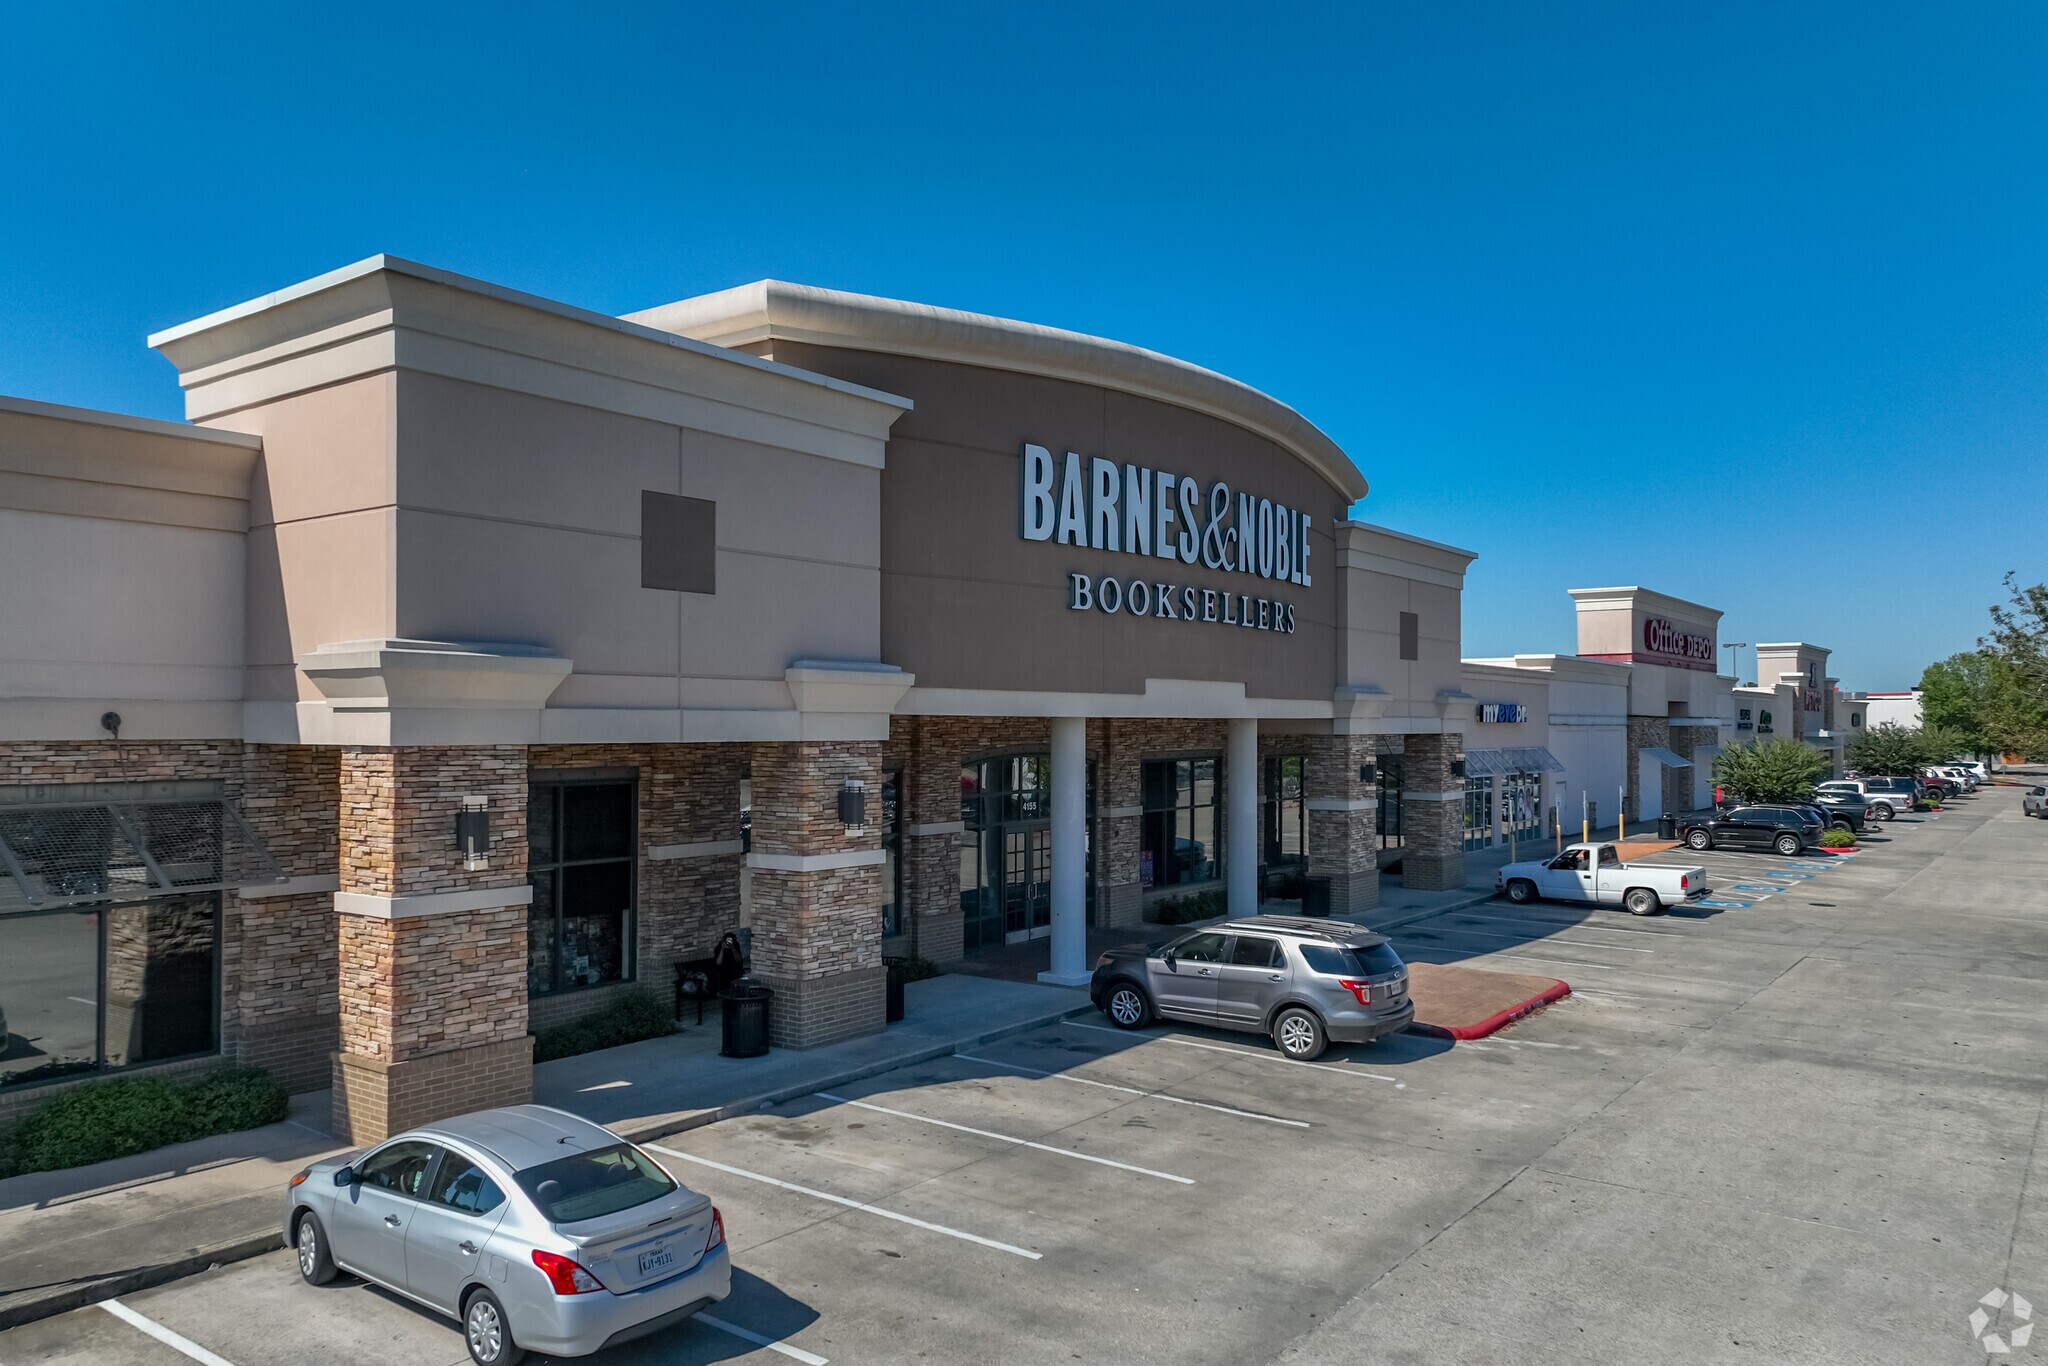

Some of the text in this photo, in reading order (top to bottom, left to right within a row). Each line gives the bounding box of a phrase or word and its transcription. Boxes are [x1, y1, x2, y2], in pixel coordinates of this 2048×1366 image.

[1070, 573, 1296, 635] BOOKSELLERS
[1650, 619, 1714, 660] Office DEPOT
[1022, 801, 1037, 811] 4155
[649, 1249, 663, 1257] TEXAS
